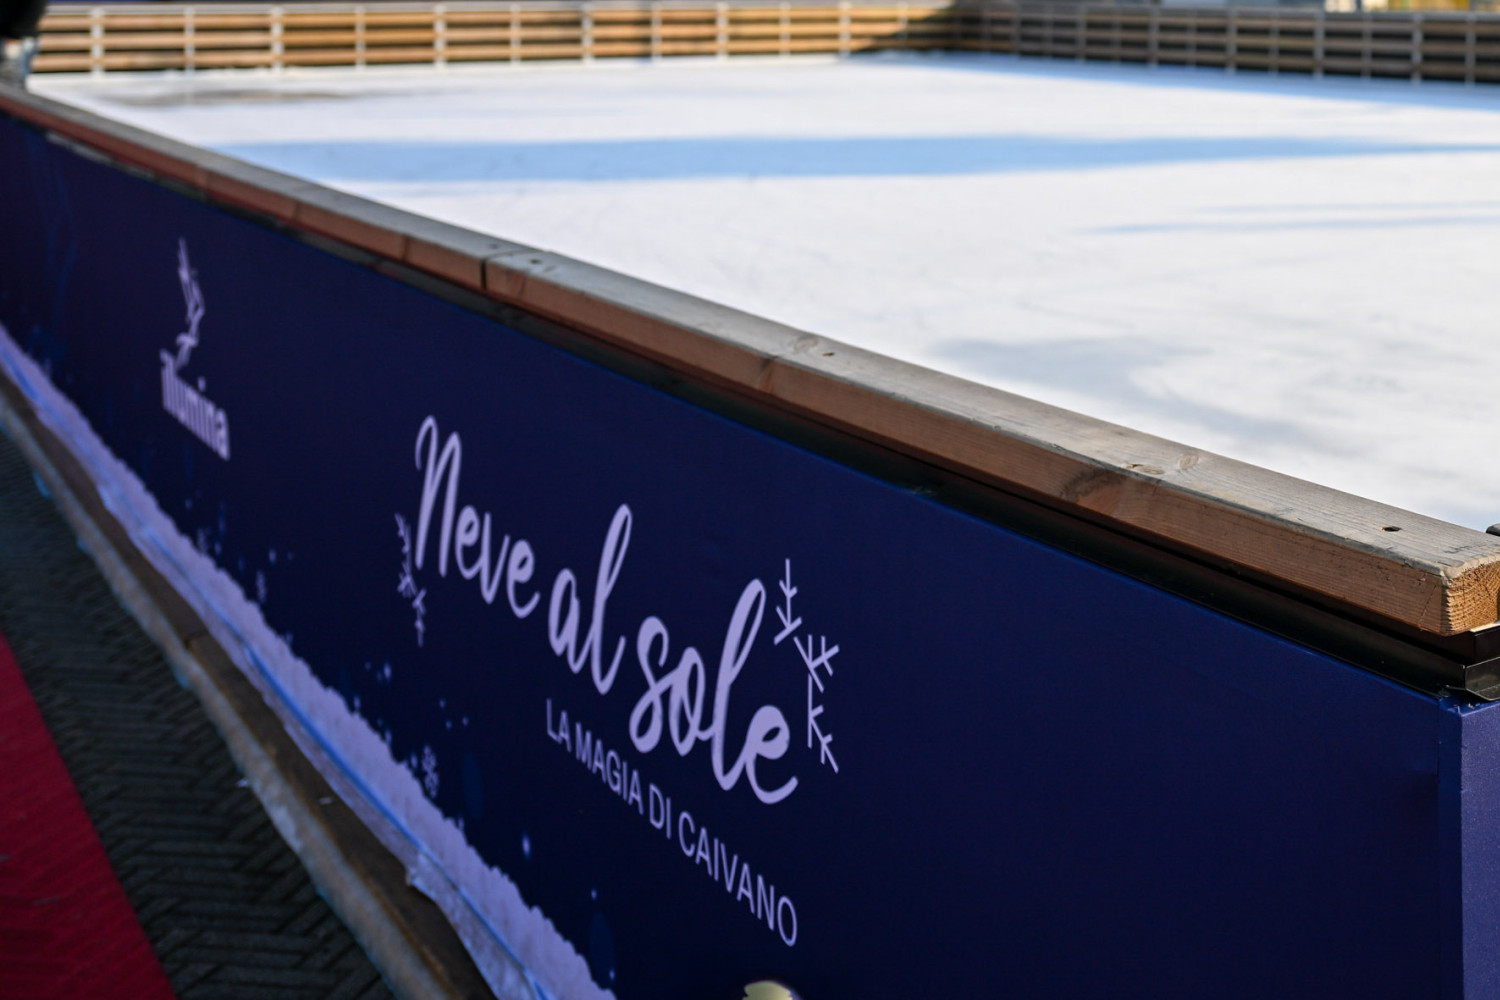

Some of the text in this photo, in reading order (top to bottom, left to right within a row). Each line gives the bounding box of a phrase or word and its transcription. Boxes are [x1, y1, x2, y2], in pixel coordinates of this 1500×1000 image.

[415, 415, 798, 804] Neve al sole
[546, 698, 798, 947] LA MAGIA DI CAIVANO
